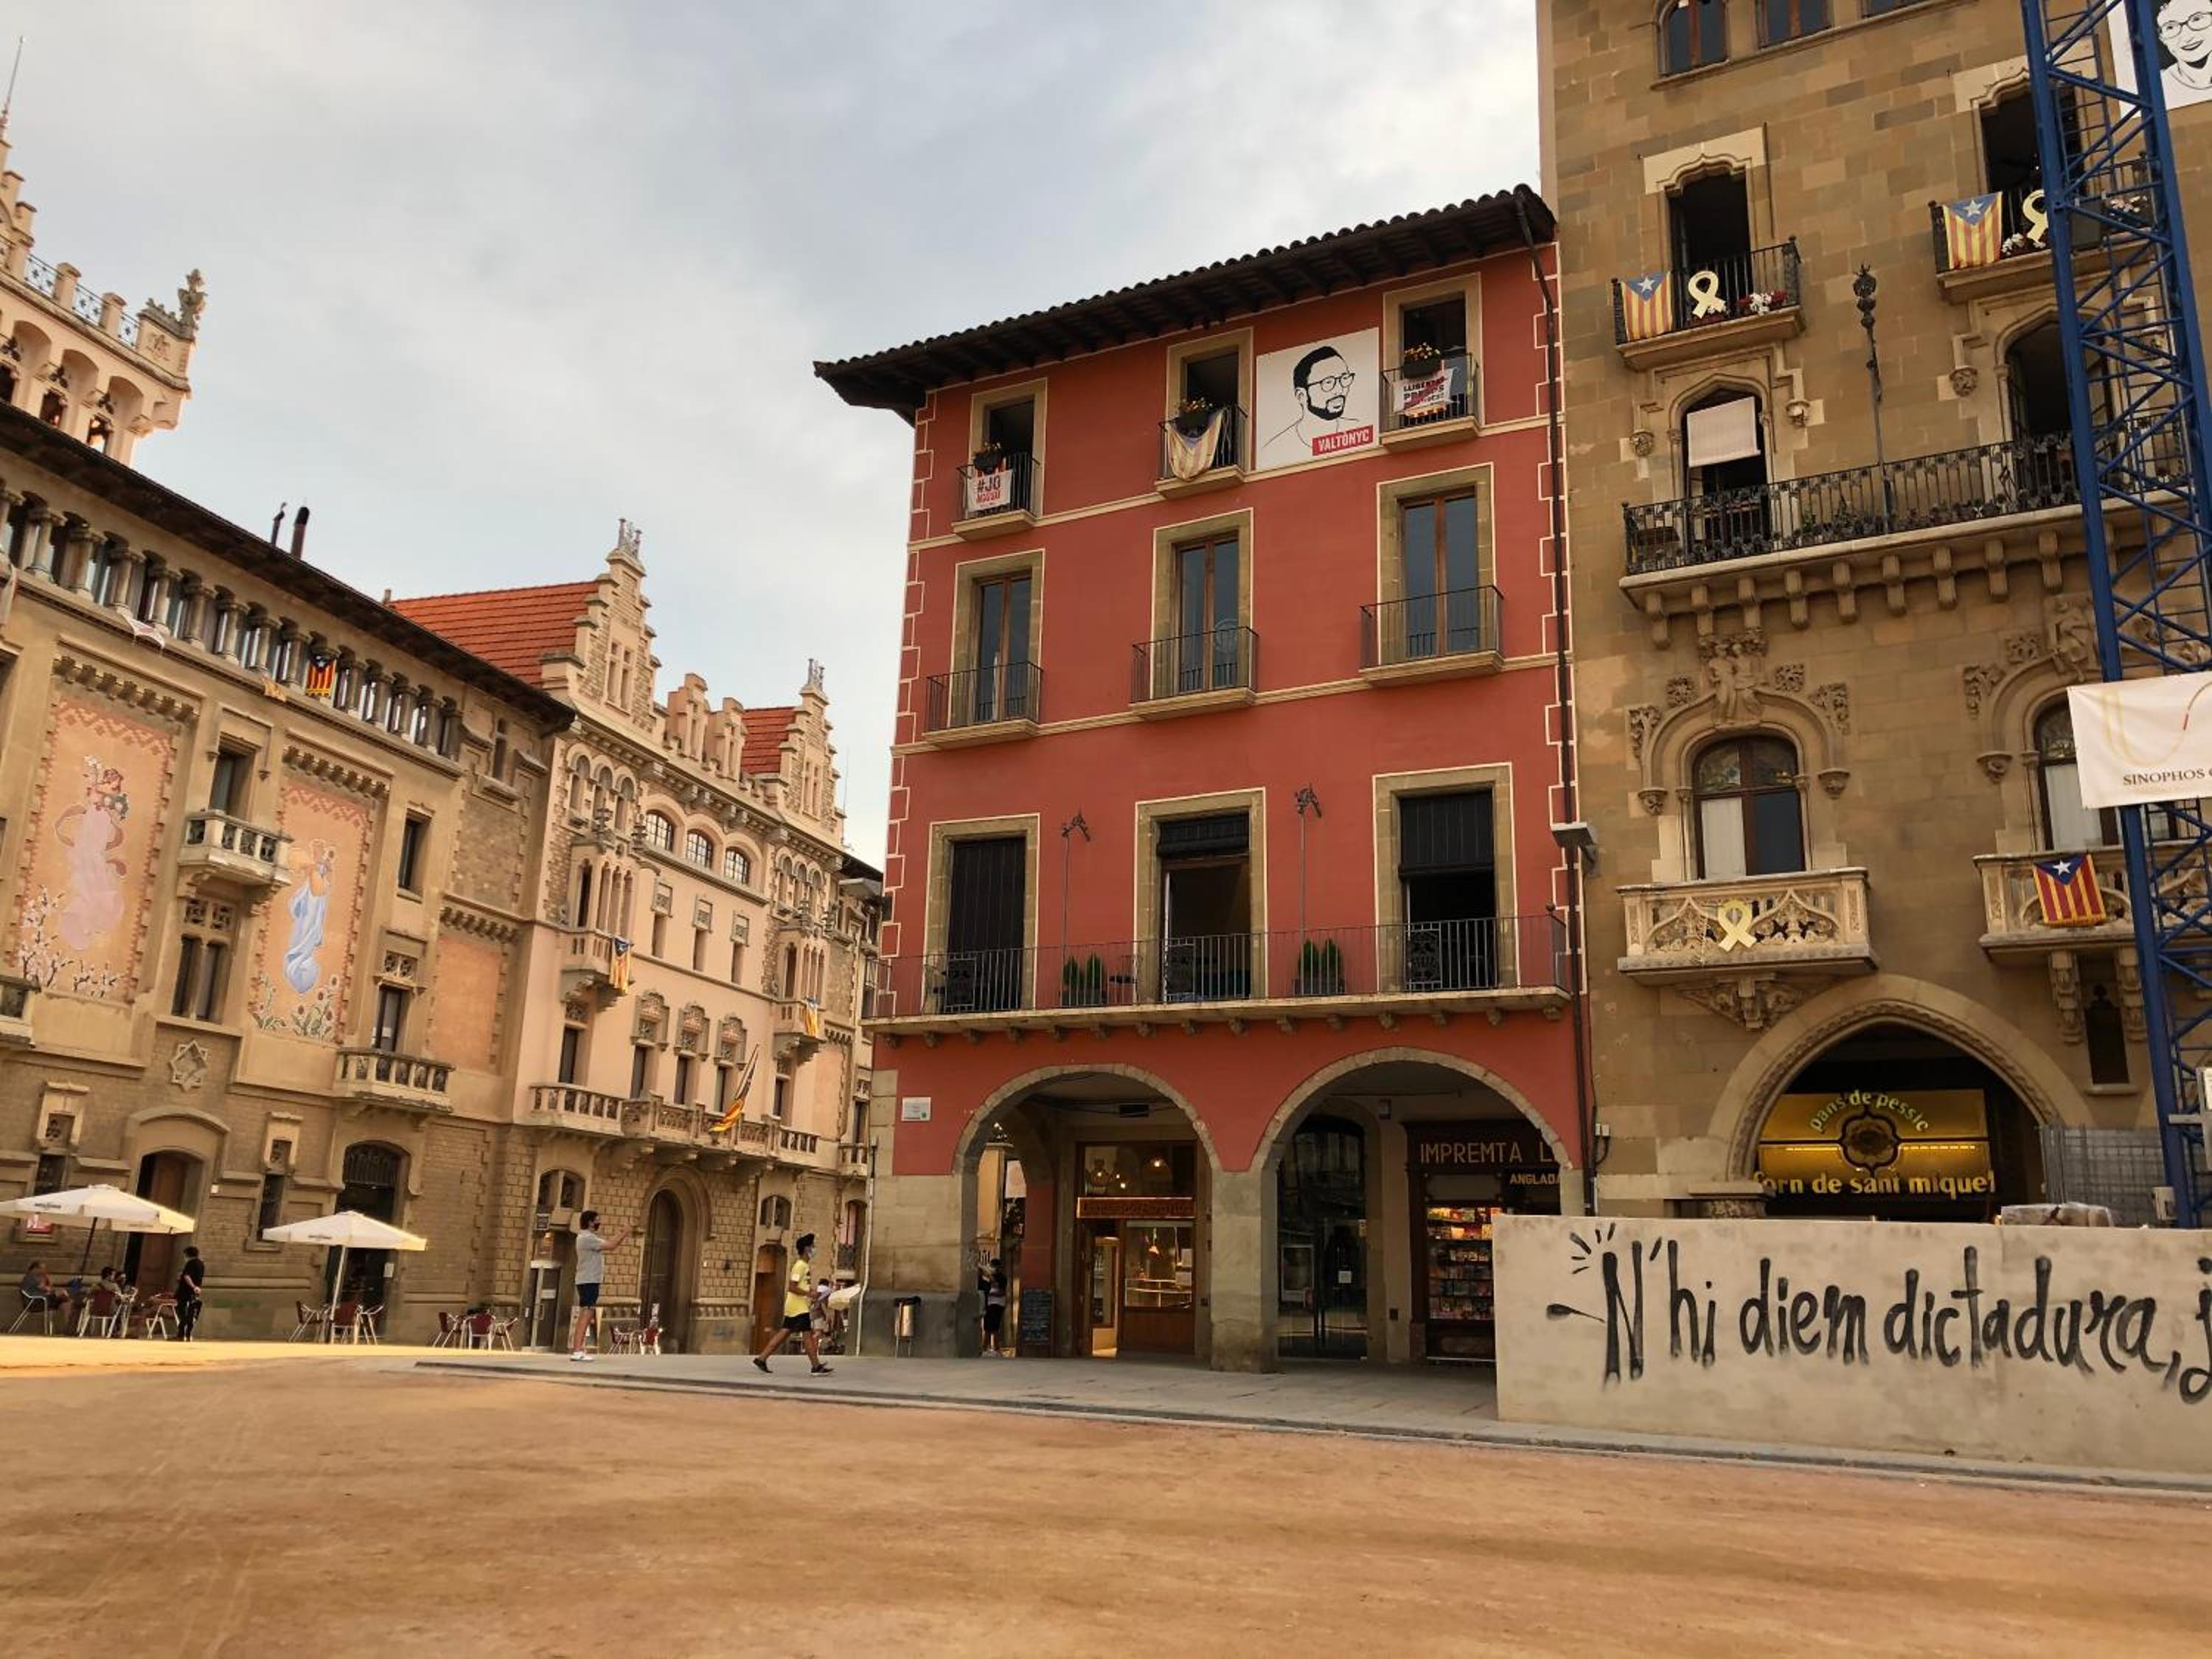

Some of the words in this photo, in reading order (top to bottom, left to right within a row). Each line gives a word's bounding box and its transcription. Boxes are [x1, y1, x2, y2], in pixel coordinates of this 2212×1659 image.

[1318, 428, 1369, 452] VALTONYC
[2123, 768, 2205, 786] SINOPHOS
[1809, 1097, 1846, 1133] pans
[1848, 1089, 1872, 1105] de
[1876, 1093, 1929, 1132] pessic
[1420, 1141, 1523, 1164] IMPREMTA
[1812, 1172, 1843, 1194] de
[1908, 1169, 1996, 1200] miquel
[1602, 1237, 1717, 1392] N'hi
[1739, 1256, 1870, 1367] diem
[1883, 1245, 2181, 1394] dictadura,
